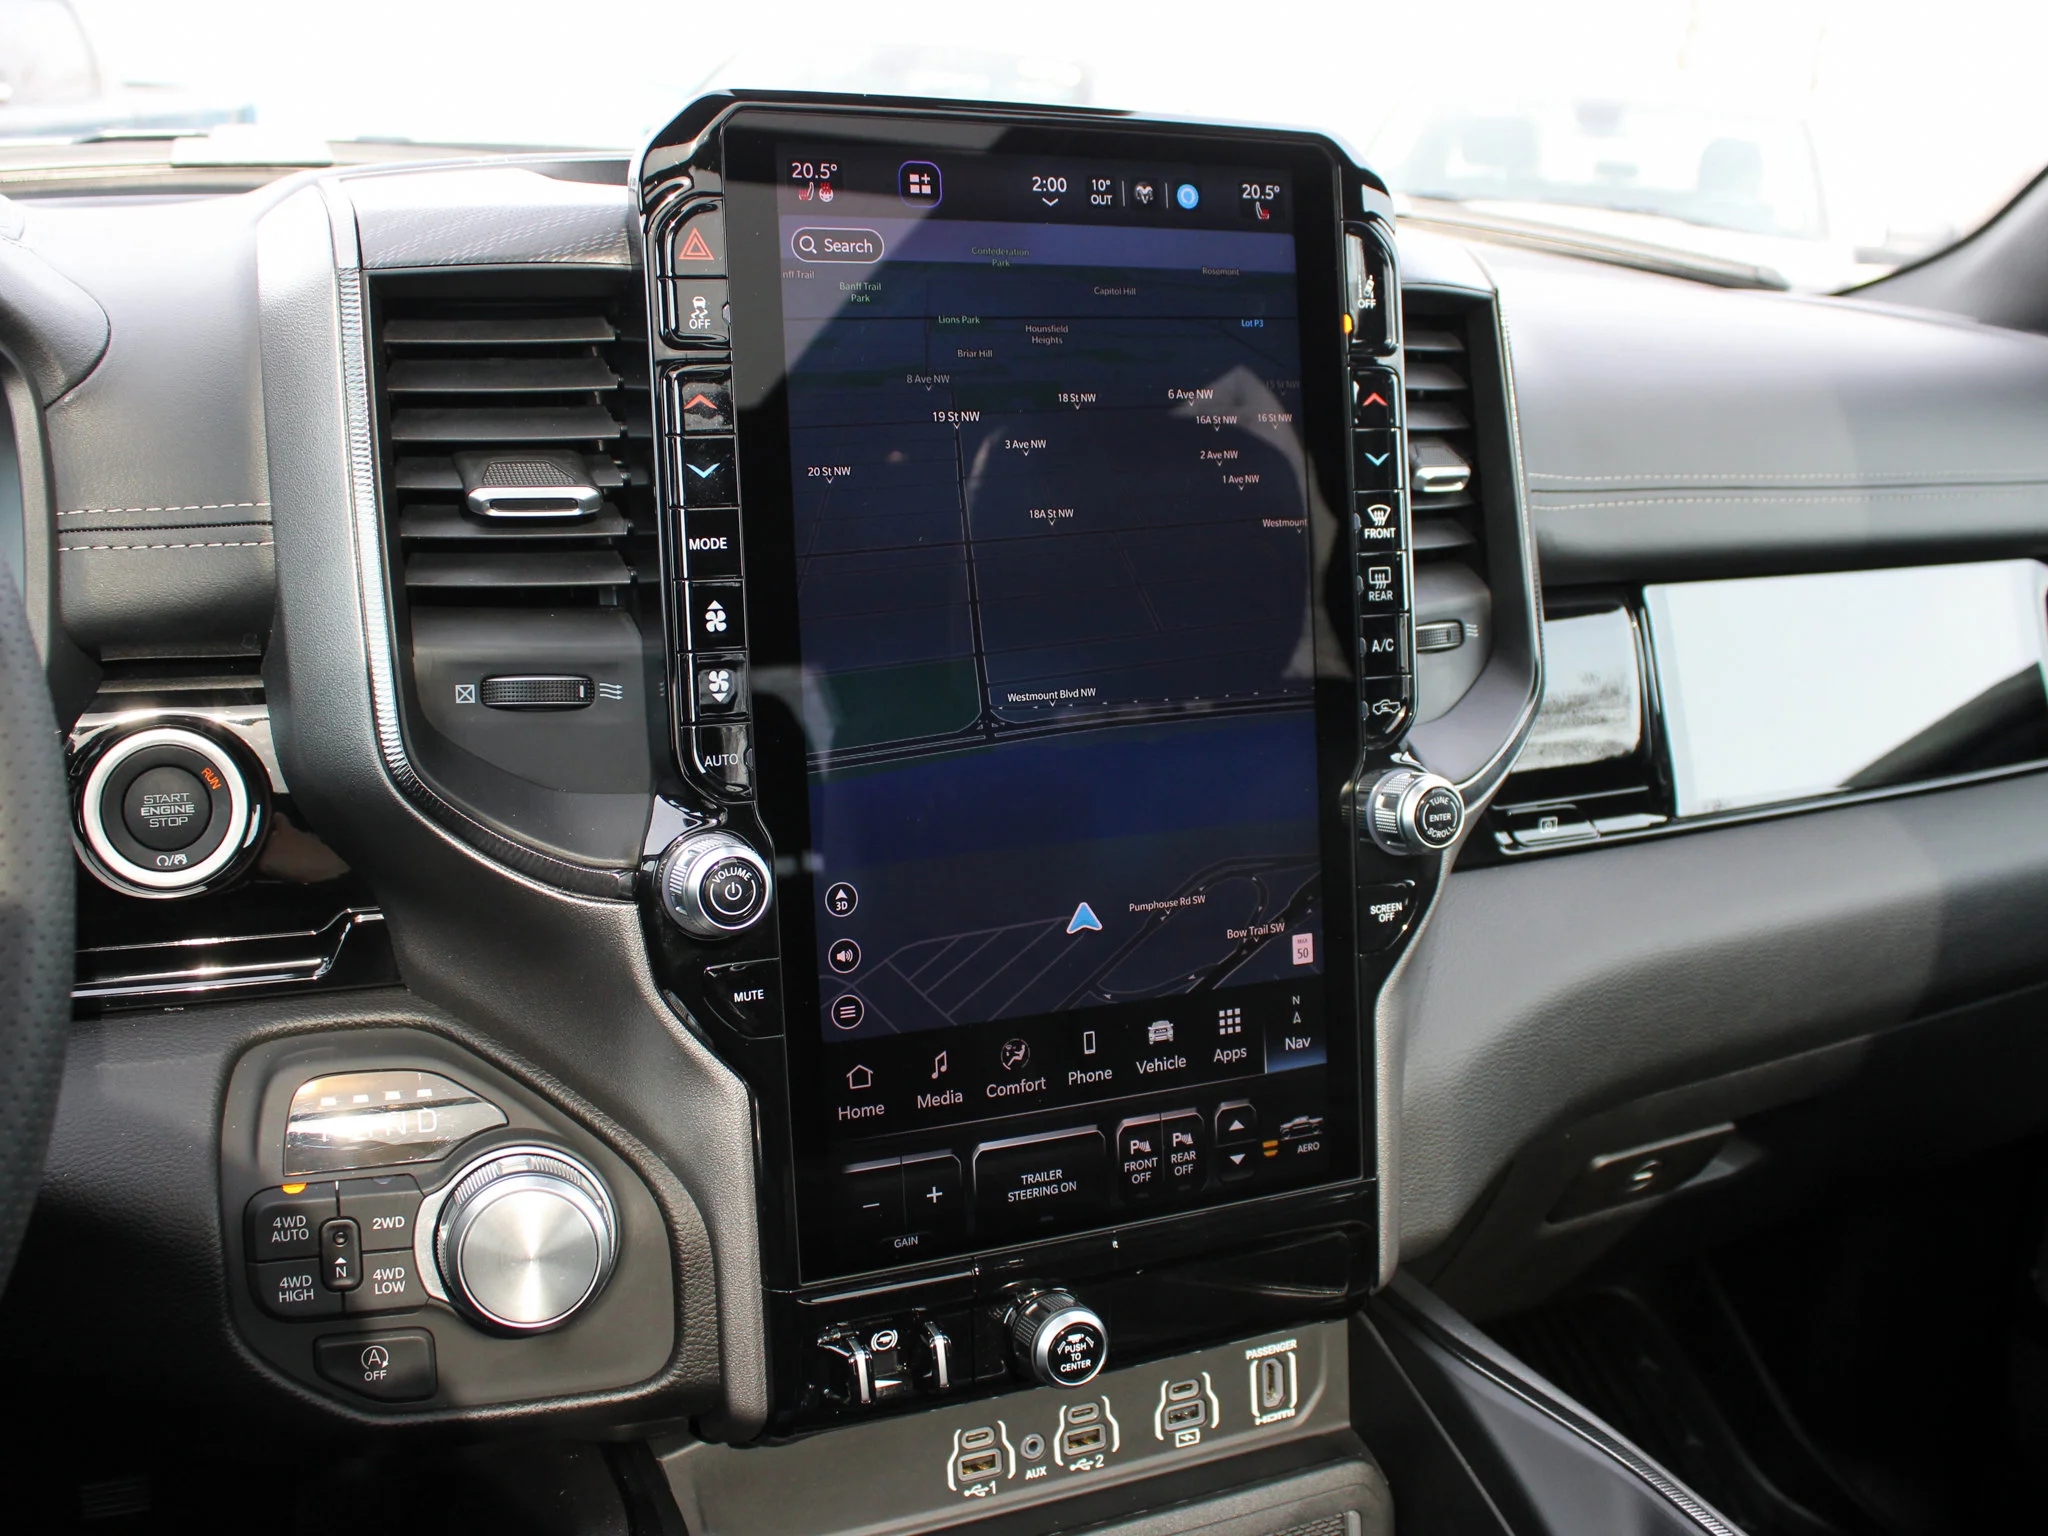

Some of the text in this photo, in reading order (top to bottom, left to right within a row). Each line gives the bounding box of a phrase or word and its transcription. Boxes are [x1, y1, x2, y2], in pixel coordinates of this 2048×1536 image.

[791, 162, 838, 179] 20.5°
[1032, 176, 1067, 192] 2:00
[1091, 179, 1111, 191] 10°
[1242, 184, 1280, 200] 20.5°
[1090, 194, 1113, 205] OUT
[824, 238, 873, 253] Search
[971, 246, 1030, 256] Confederation
[991, 258, 1010, 267] Park
[796, 270, 815, 280] Trail
[1202, 266, 1240, 276] Rosemont
[839, 282, 882, 291] Banff Trail
[1093, 286, 1136, 296] Capitol Hill
[851, 294, 870, 302] Park
[1357, 299, 1377, 309] OFF
[689, 319, 711, 329] OFF
[938, 316, 980, 324] Lions Park
[1241, 318, 1264, 328] Lot P3
[1025, 325, 1069, 333] Hounsfield
[1031, 336, 1063, 345] Heights
[957, 349, 993, 358] Briar Hill
[906, 374, 950, 384] 8 Ave NW
[1058, 393, 1096, 403] 18 St NW
[1168, 389, 1214, 399] 6 Ave NW
[932, 411, 980, 422] 19 St NW
[1196, 416, 1238, 424] 16A St NW
[1257, 414, 1293, 422] 16 St NW
[1005, 440, 1047, 449] 3 Ave NW
[1200, 450, 1239, 460] 2 Ave NW
[807, 466, 851, 477] 20 St NW
[1222, 474, 1260, 484] 1 Ave NW
[1029, 508, 1074, 519] 18A St NW
[1262, 518, 1308, 528] Westmount
[1364, 527, 1396, 540] FRONT
[689, 537, 728, 551] MODE
[1368, 590, 1393, 601] REAR
[1371, 638, 1394, 653] A/C
[1007, 687, 1096, 702] Westmount Blvd NW
[704, 753, 739, 767] AUTO
[201, 767, 222, 790] RUN
[143, 793, 190, 804] START
[1430, 796, 1450, 807] TUNE
[140, 804, 195, 817] ENGINE
[149, 816, 188, 828] STOP
[1429, 813, 1452, 823] ENTER
[1427, 825, 1456, 838] SCROLL
[712, 867, 752, 884] VOLUME
[835, 901, 848, 911] 3D
[1128, 894, 1206, 913] Pumphouse Rd SW
[1370, 902, 1403, 915] SCREEN
[1378, 913, 1395, 923] OFF
[1226, 922, 1286, 940] Bow Trail SW
[1297, 947, 1309, 959] 50
[734, 989, 764, 1003] MUTE
[1292, 995, 1300, 1005] N
[1285, 1036, 1311, 1051] Nav
[1213, 1047, 1247, 1063] Apps
[1136, 1055, 1187, 1075] Vehicle
[1068, 1067, 1113, 1086] Phone
[986, 1076, 1046, 1098] Comfort
[917, 1090, 963, 1109] Media
[838, 1104, 885, 1121] Home
[417, 1109, 438, 1133] D
[1297, 1142, 1320, 1154] AERO
[1171, 1151, 1196, 1164] REAR
[1124, 1157, 1158, 1173] FRONT
[1174, 1164, 1194, 1176] OFF
[1021, 1169, 1063, 1185] TRAILER
[1131, 1171, 1151, 1184] OFF
[1007, 1181, 1077, 1202] STEERING ON
[273, 1215, 307, 1227] 4WD
[372, 1216, 405, 1230] 2WD
[271, 1229, 309, 1243] AUTO
[894, 1236, 919, 1248] GAIN
[336, 1266, 347, 1278] N
[372, 1267, 405, 1281] 4WD
[280, 1275, 312, 1289] 4WD
[374, 1281, 405, 1295] LOW
[278, 1288, 315, 1303] HIGH
[1065, 1342, 1087, 1354] PUSH
[1245, 1339, 1298, 1360] PASSENGER
[1070, 1353, 1082, 1362] TO
[1060, 1359, 1092, 1373] CENTER
[364, 1370, 387, 1382] OFF
[1095, 1454, 1105, 1468] 2
[1025, 1466, 1048, 1480] AUX
[989, 1480, 997, 1495] 1
